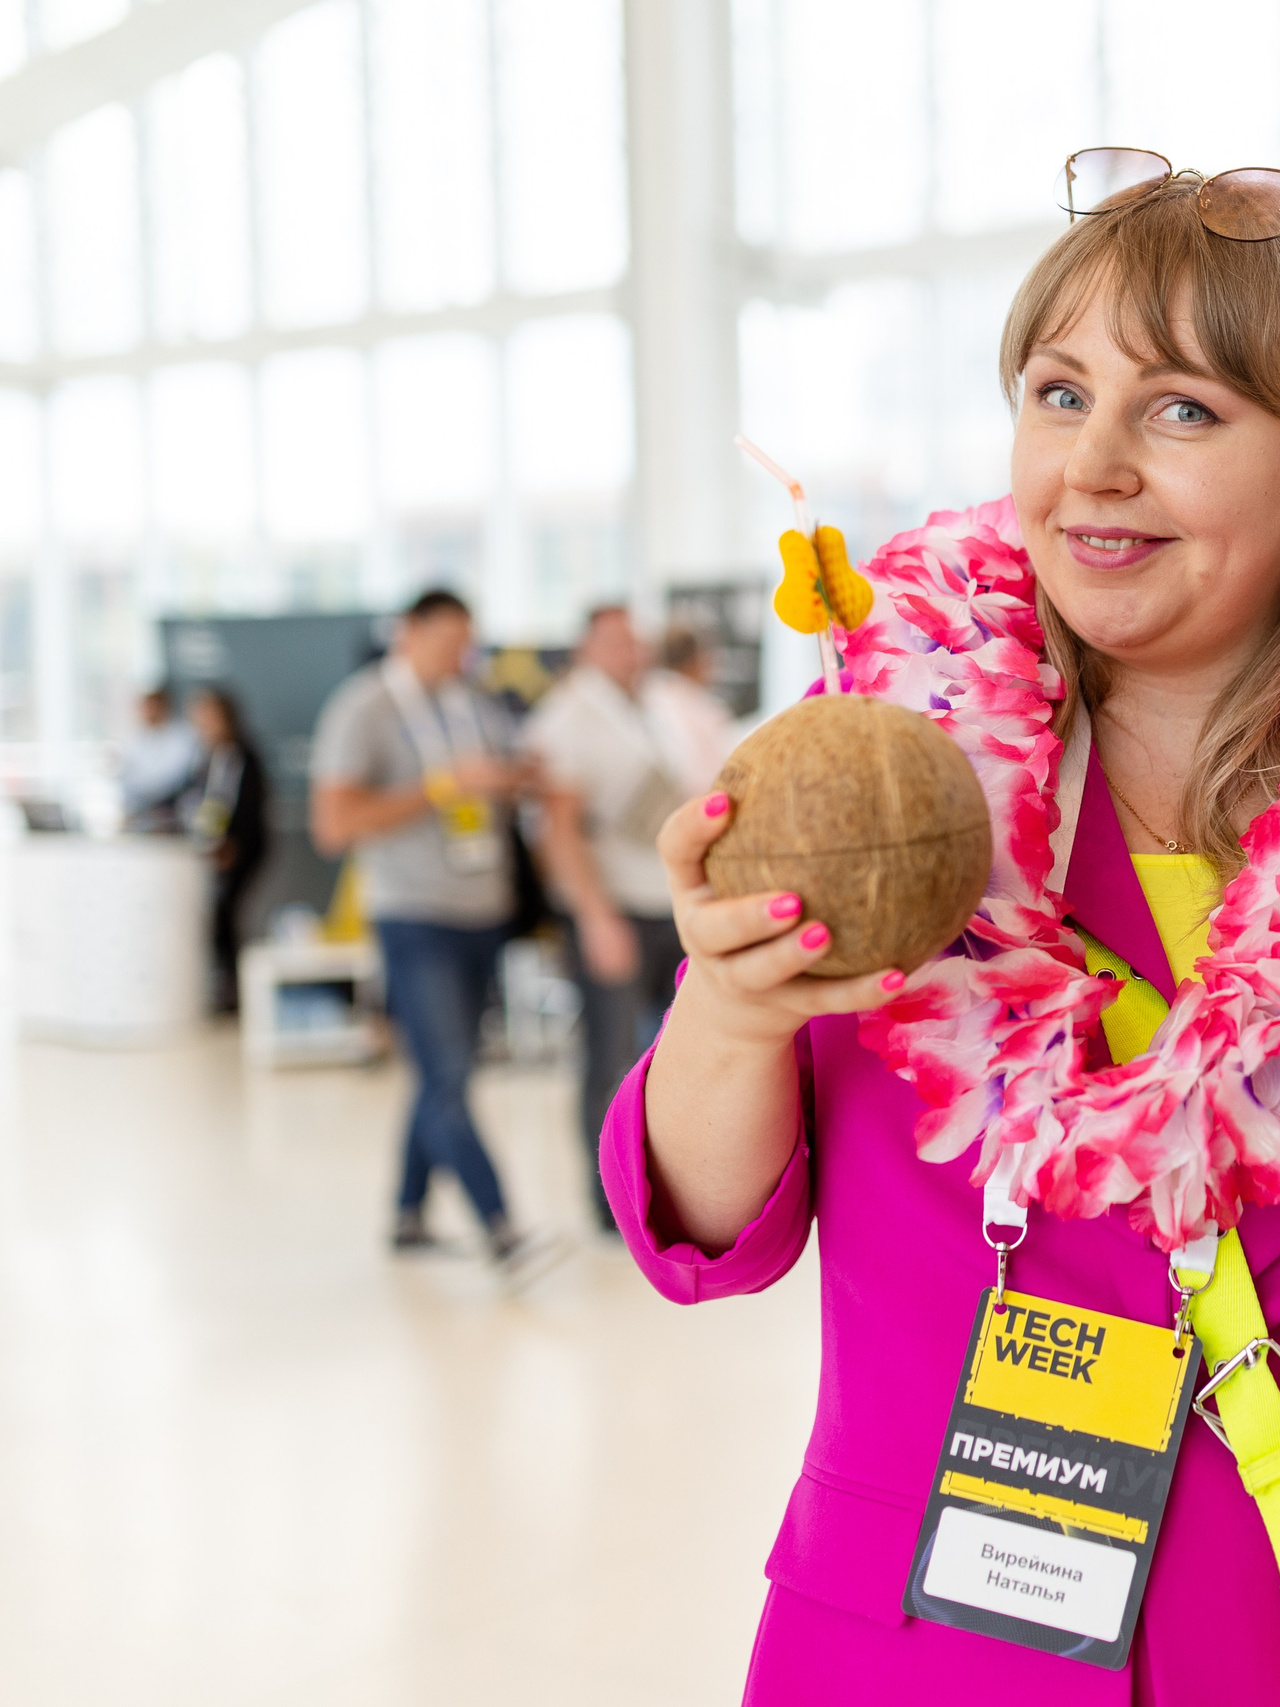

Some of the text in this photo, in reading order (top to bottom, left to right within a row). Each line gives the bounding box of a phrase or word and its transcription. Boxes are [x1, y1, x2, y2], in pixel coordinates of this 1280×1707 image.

[1004, 1305, 1105, 1355] TECH
[996, 1336, 1096, 1383] WEEK
[950, 1432, 1107, 1493] ПРЕМИУМ
[981, 1544, 1083, 1582] Вирейкина
[987, 1570, 1065, 1602] Наталья
